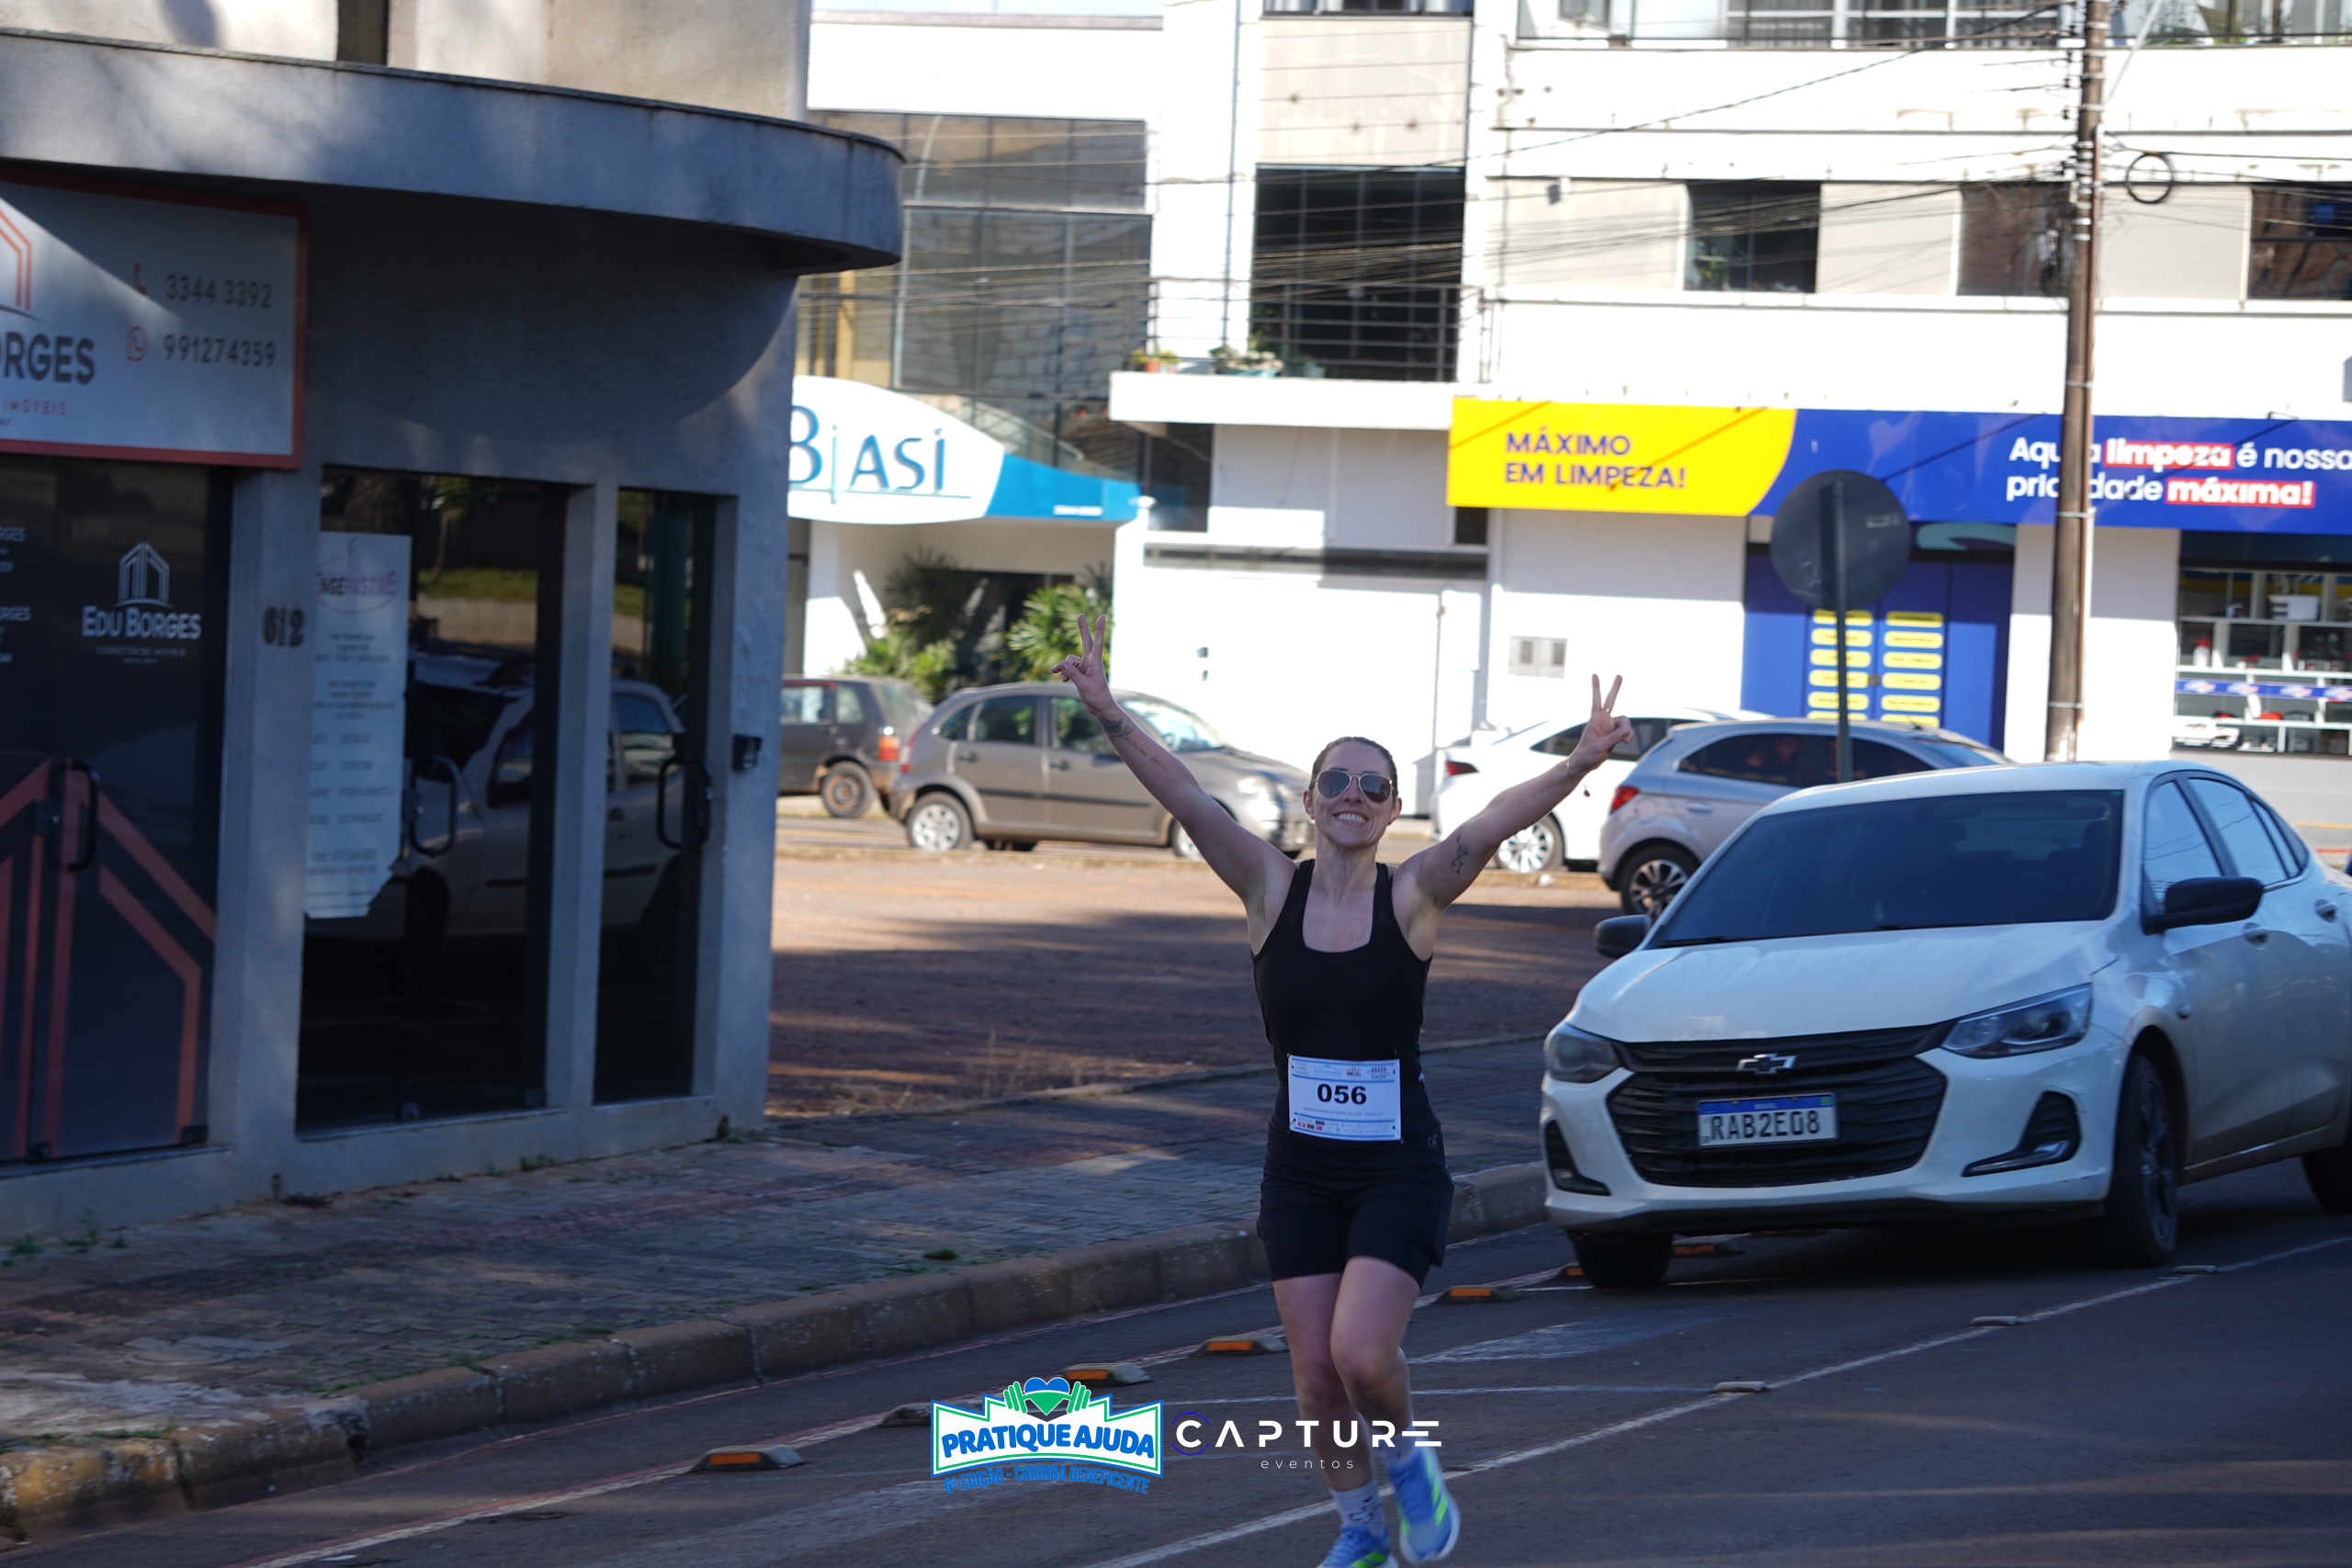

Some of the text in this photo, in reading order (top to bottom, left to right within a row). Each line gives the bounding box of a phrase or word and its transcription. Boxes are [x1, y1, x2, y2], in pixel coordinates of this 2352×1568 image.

[165, 274, 272, 309] 3344 3392
[0, 331, 96, 386] RGES
[1506, 426, 1632, 456] MÁXIMO
[2008, 436, 2062, 469] Aqu
[2106, 437, 2232, 473] limpeza
[2236, 441, 2258, 468] é
[1506, 462, 1686, 488] EM LIMPEZA!
[2168, 476, 2313, 505] máxima!
[125, 607, 202, 639] BORGES
[1317, 1084, 1367, 1105] 056
[1711, 1111, 1820, 1141] RAB2E08
